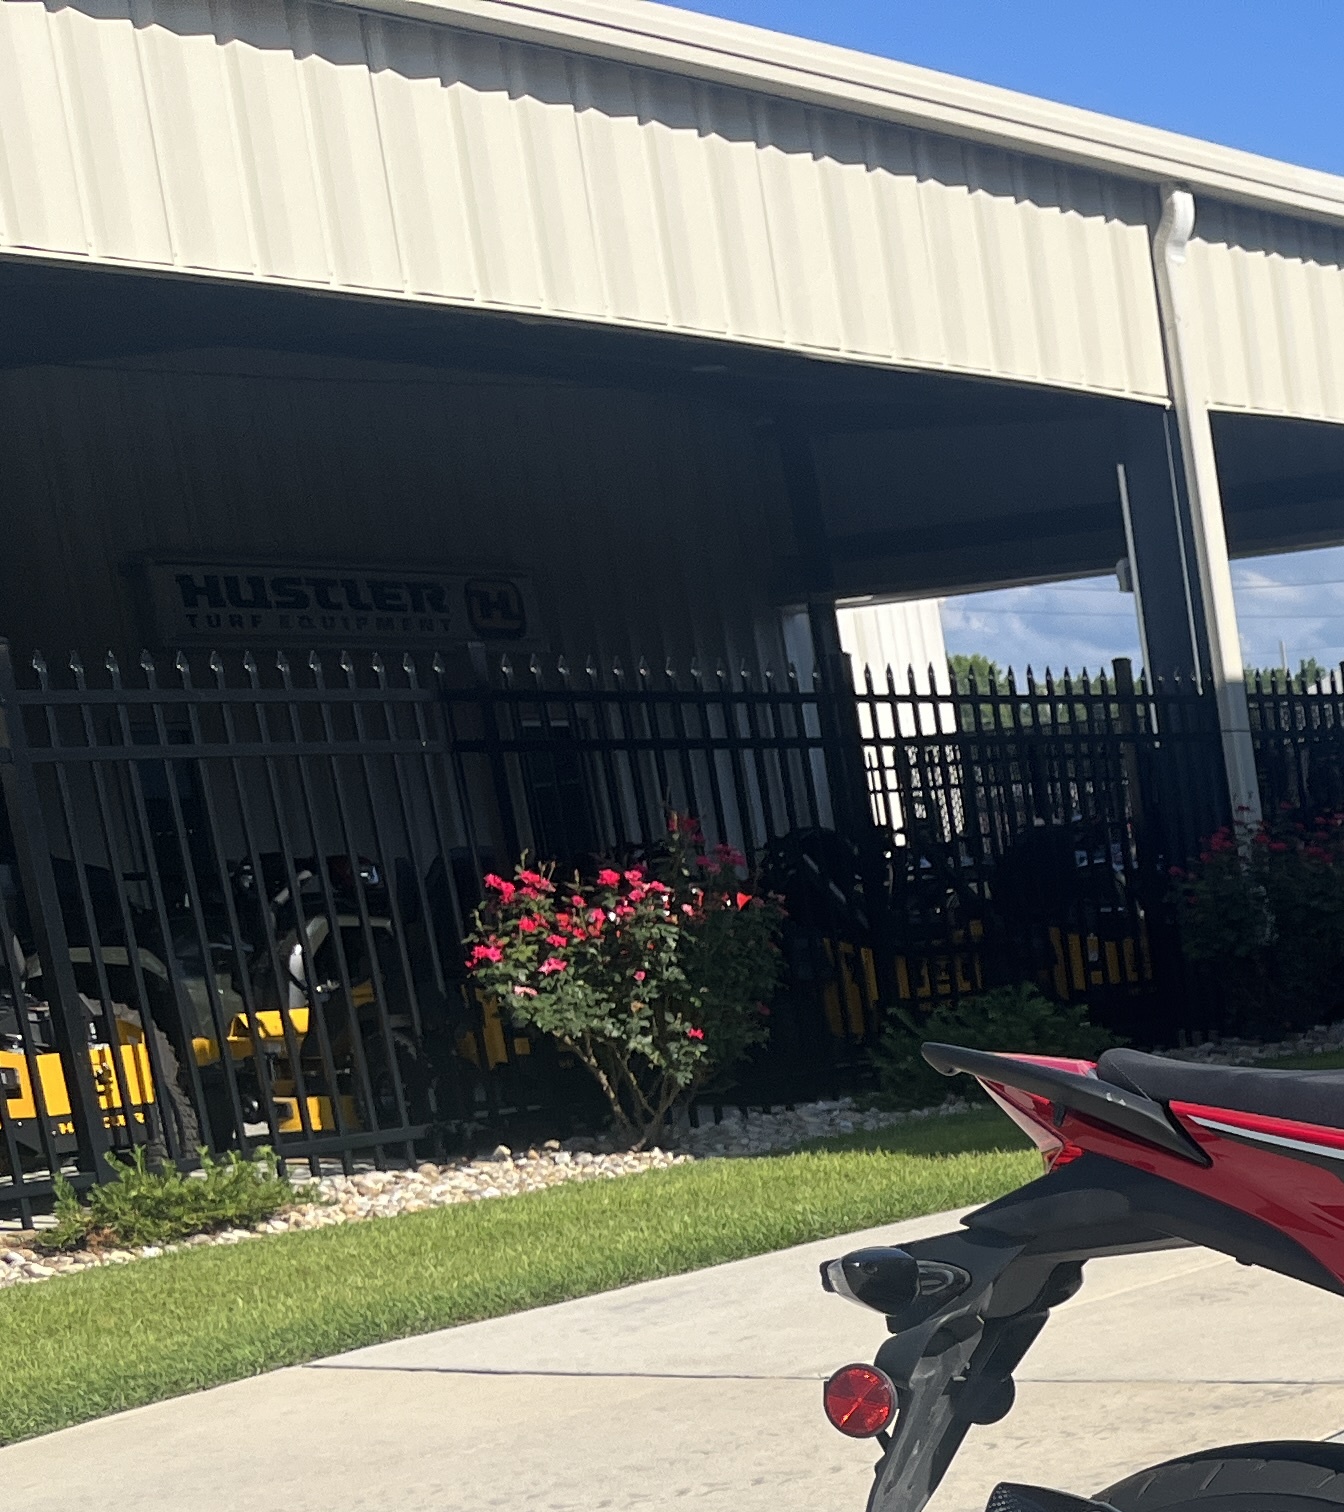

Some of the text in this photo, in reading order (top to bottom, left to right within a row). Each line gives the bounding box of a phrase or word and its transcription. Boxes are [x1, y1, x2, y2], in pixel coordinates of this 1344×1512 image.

[176, 573, 451, 613] HUSTLER
[185, 613, 452, 632] TURF EQUIPMENT
